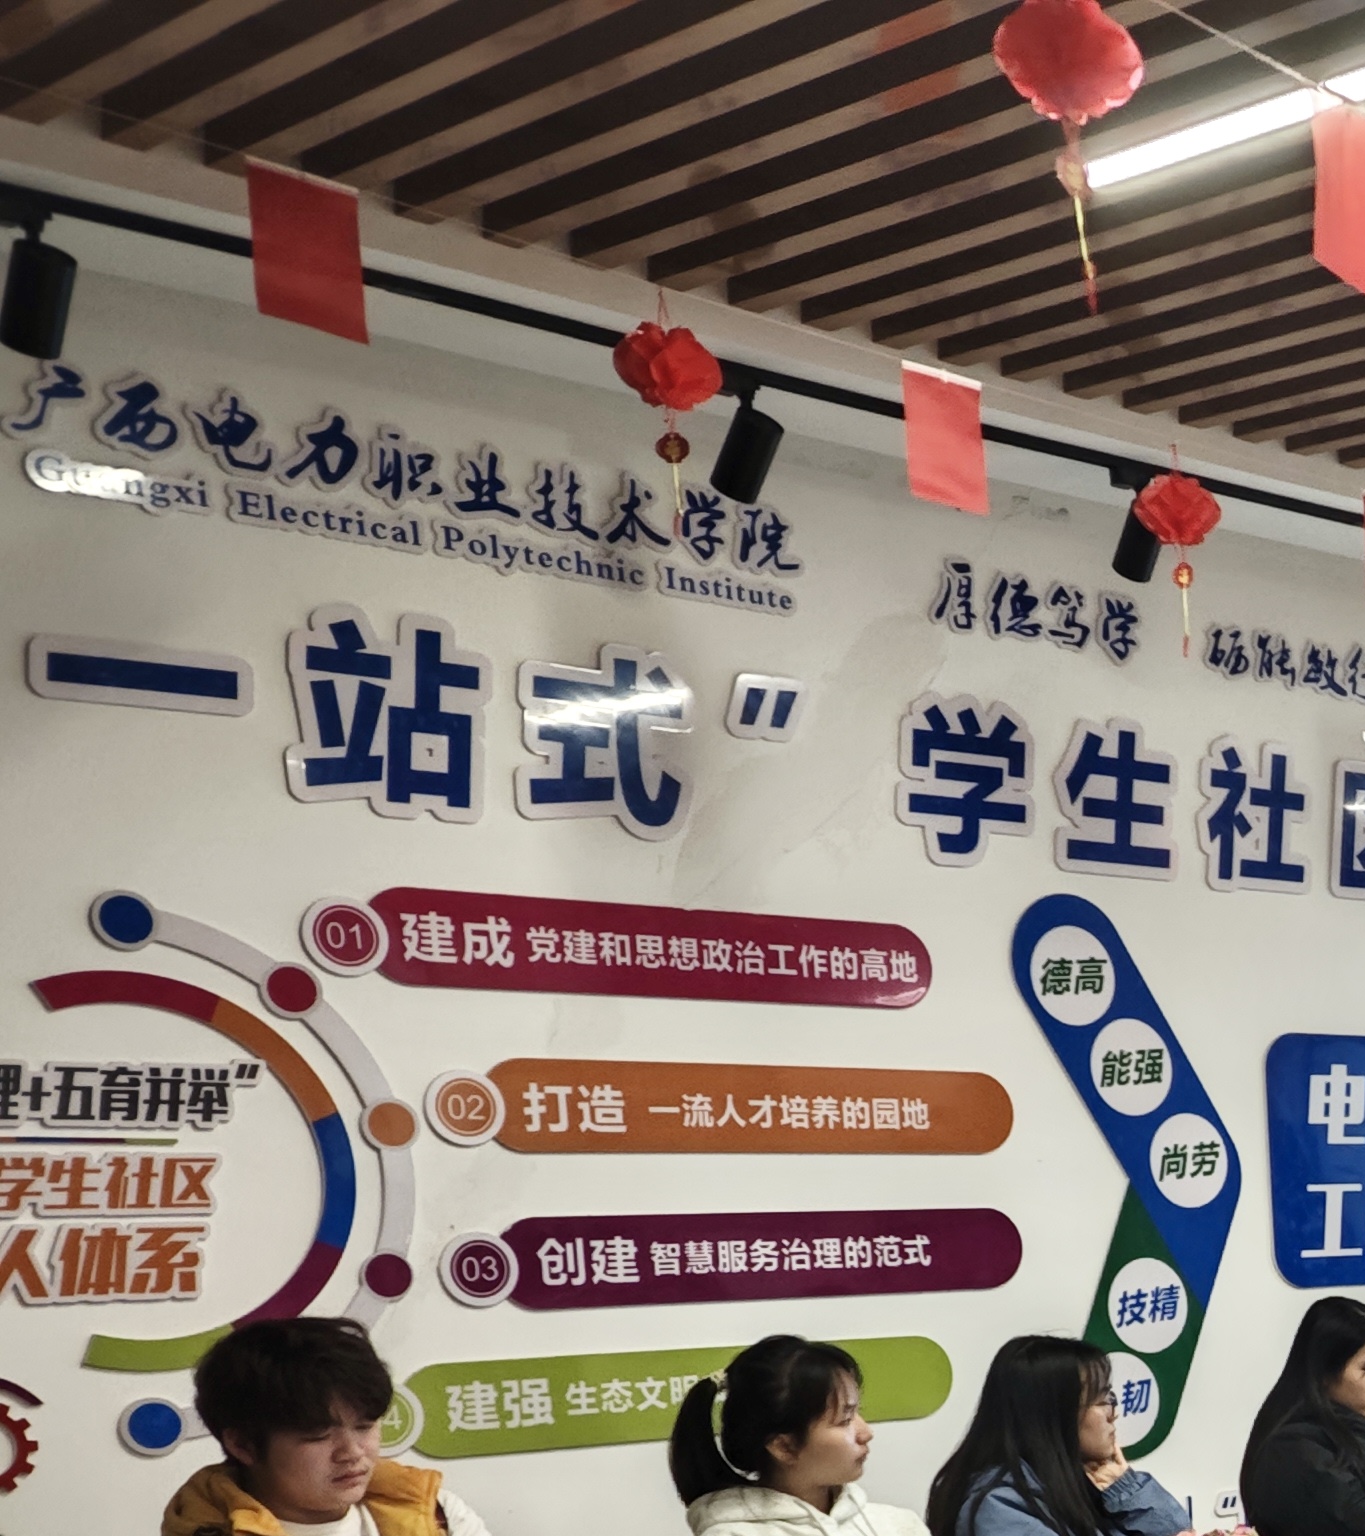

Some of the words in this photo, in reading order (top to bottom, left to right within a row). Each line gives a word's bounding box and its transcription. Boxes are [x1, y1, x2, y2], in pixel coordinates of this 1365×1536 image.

[12, 366, 800, 570] 广西电力职业技术学院
[237, 490, 423, 547] Electrical
[443, 525, 645, 586] Polytechnic
[665, 566, 793, 610] Institute
[934, 561, 1139, 660] 厚德笃学
[325, 922, 362, 951] 01
[400, 912, 515, 969] 建成
[526, 925, 918, 984] 党建和思想政治工作的高地
[1039, 957, 1107, 996] 德高
[1099, 1048, 1164, 1088] 能强
[446, 1095, 486, 1121] 02
[523, 1084, 628, 1134] 打造
[648, 1093, 931, 1131] 一流人才培养的园地
[1158, 1142, 1221, 1182] 尚劳
[462, 1256, 499, 1282] 03
[536, 1236, 640, 1287] 创建
[649, 1233, 932, 1278] 智慧服务治理的范式
[1115, 1284, 1181, 1327] 技精
[445, 1377, 555, 1432] 建强
